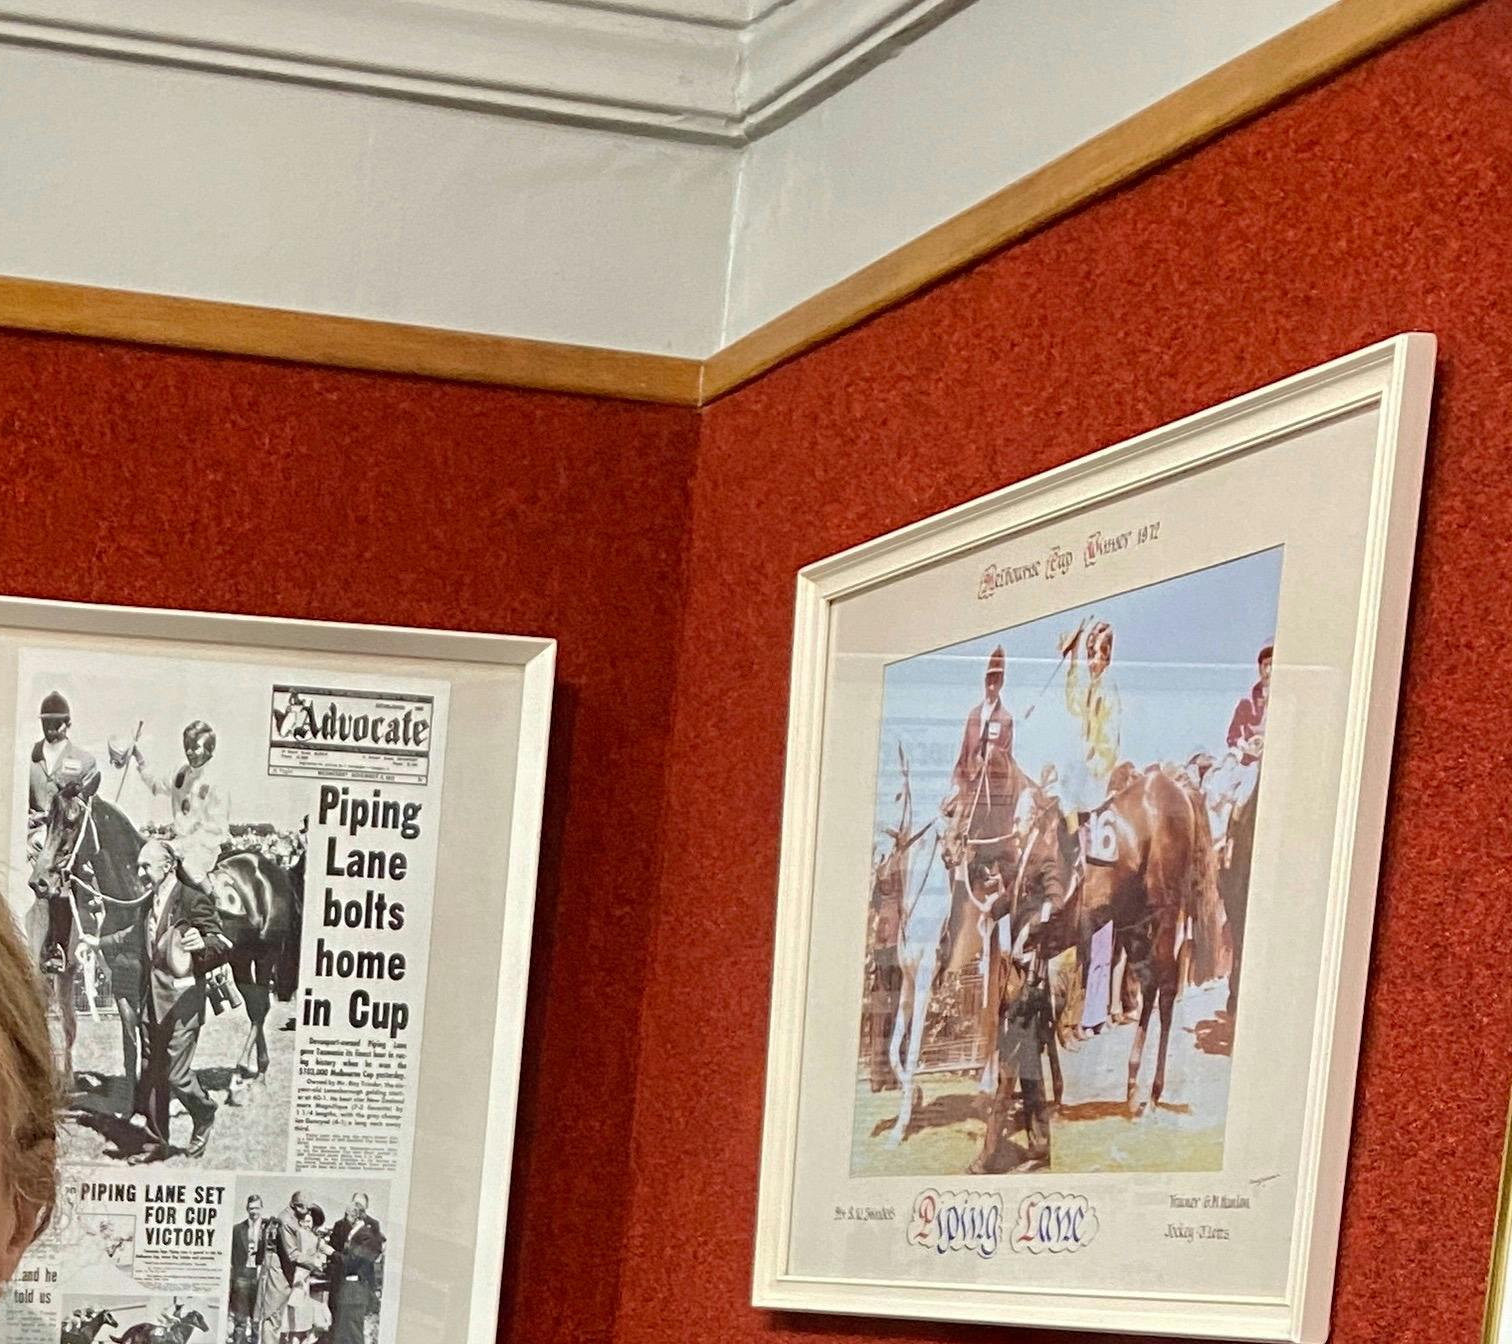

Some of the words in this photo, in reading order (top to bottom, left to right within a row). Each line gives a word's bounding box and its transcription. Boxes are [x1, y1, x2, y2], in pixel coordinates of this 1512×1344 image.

[291, 698, 430, 747] Advocate
[319, 785, 423, 840] Piping
[326, 836, 408, 881] Lane
[323, 887, 405, 931] bolts
[315, 938, 407, 981] home
[303, 988, 332, 1027] in
[348, 989, 409, 1039] Cup
[80, 1183, 137, 1202] PIPING
[145, 1184, 187, 1204] LANE
[194, 1186, 226, 1205] SET
[144, 1206, 177, 1225] FOR
[184, 1207, 218, 1226] CUP
[145, 1228, 216, 1247] VICTORY
[914, 1195, 999, 1255] Piping
[1018, 1202, 1085, 1242] Lane
[14, 1290, 34, 1304] told
[40, 1291, 52, 1304] us
[45, 1268, 58, 1283] he
